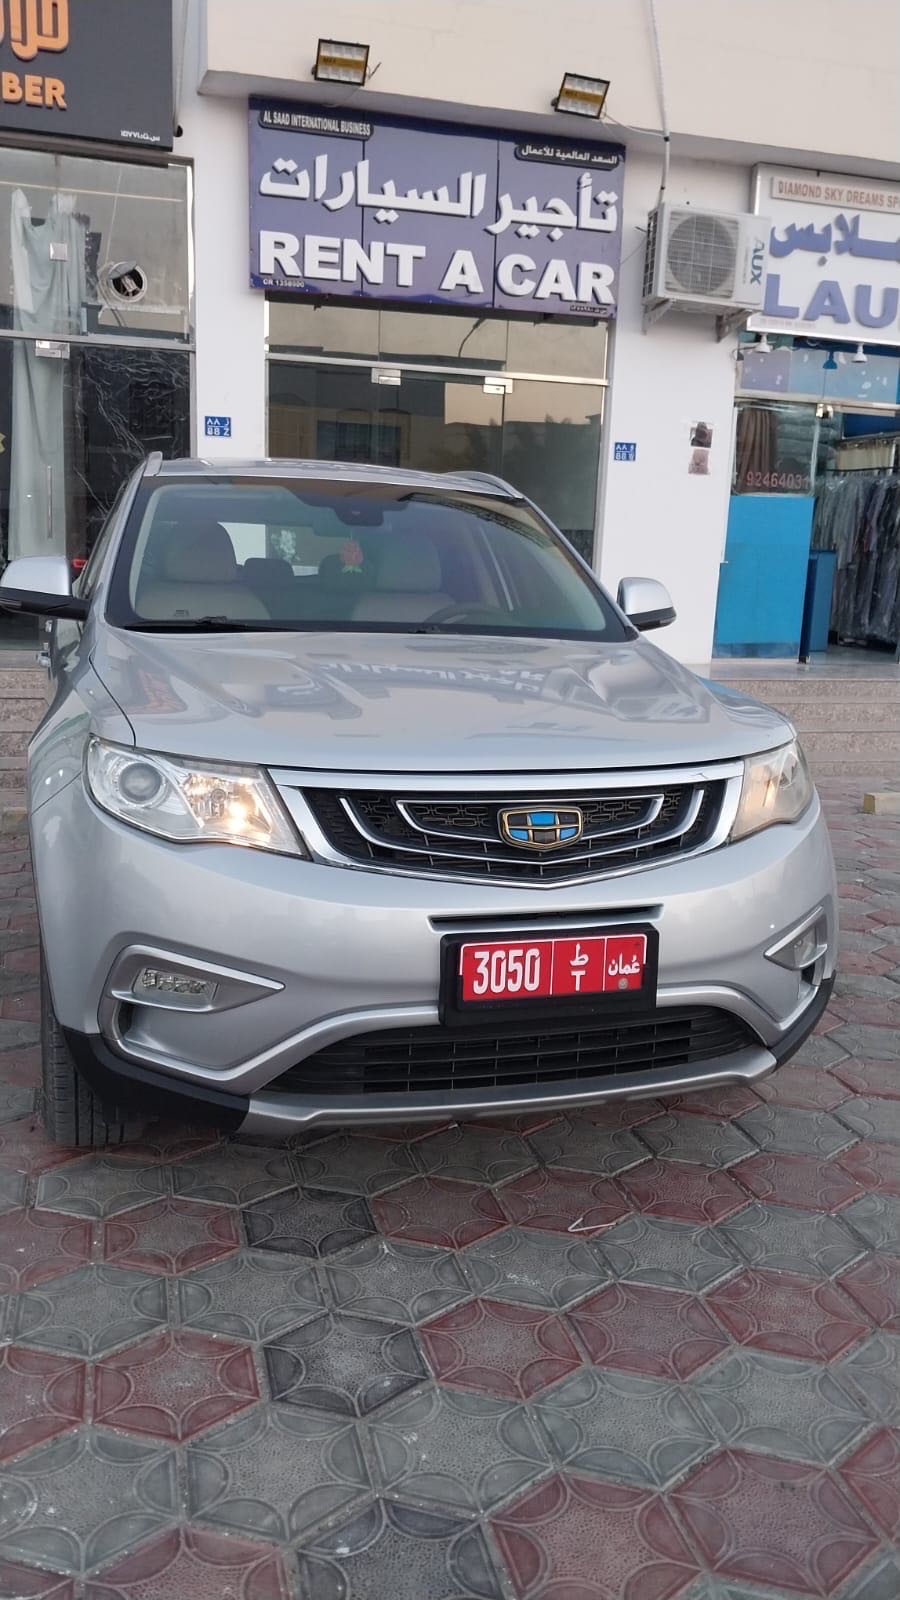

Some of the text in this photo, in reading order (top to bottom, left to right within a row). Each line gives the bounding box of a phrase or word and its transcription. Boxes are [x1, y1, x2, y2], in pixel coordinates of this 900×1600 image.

[263, 110, 371, 136] AL SAAD INTERNATIONAL BUSINESS
[556, 149, 590, 161] العالمية
[591, 155, 618, 164] السعد
[259, 154, 619, 241] تأجير السيارات
[778, 181, 821, 198] DIAMOND
[824, 187, 845, 201] SKY
[846, 190, 884, 207] DREAMS
[259, 230, 616, 305] RENT A CAR
[750, 239, 765, 285] AUX
[569, 943, 590, 967] ط
[473, 948, 541, 995] 3050
[571, 970, 586, 991] T
